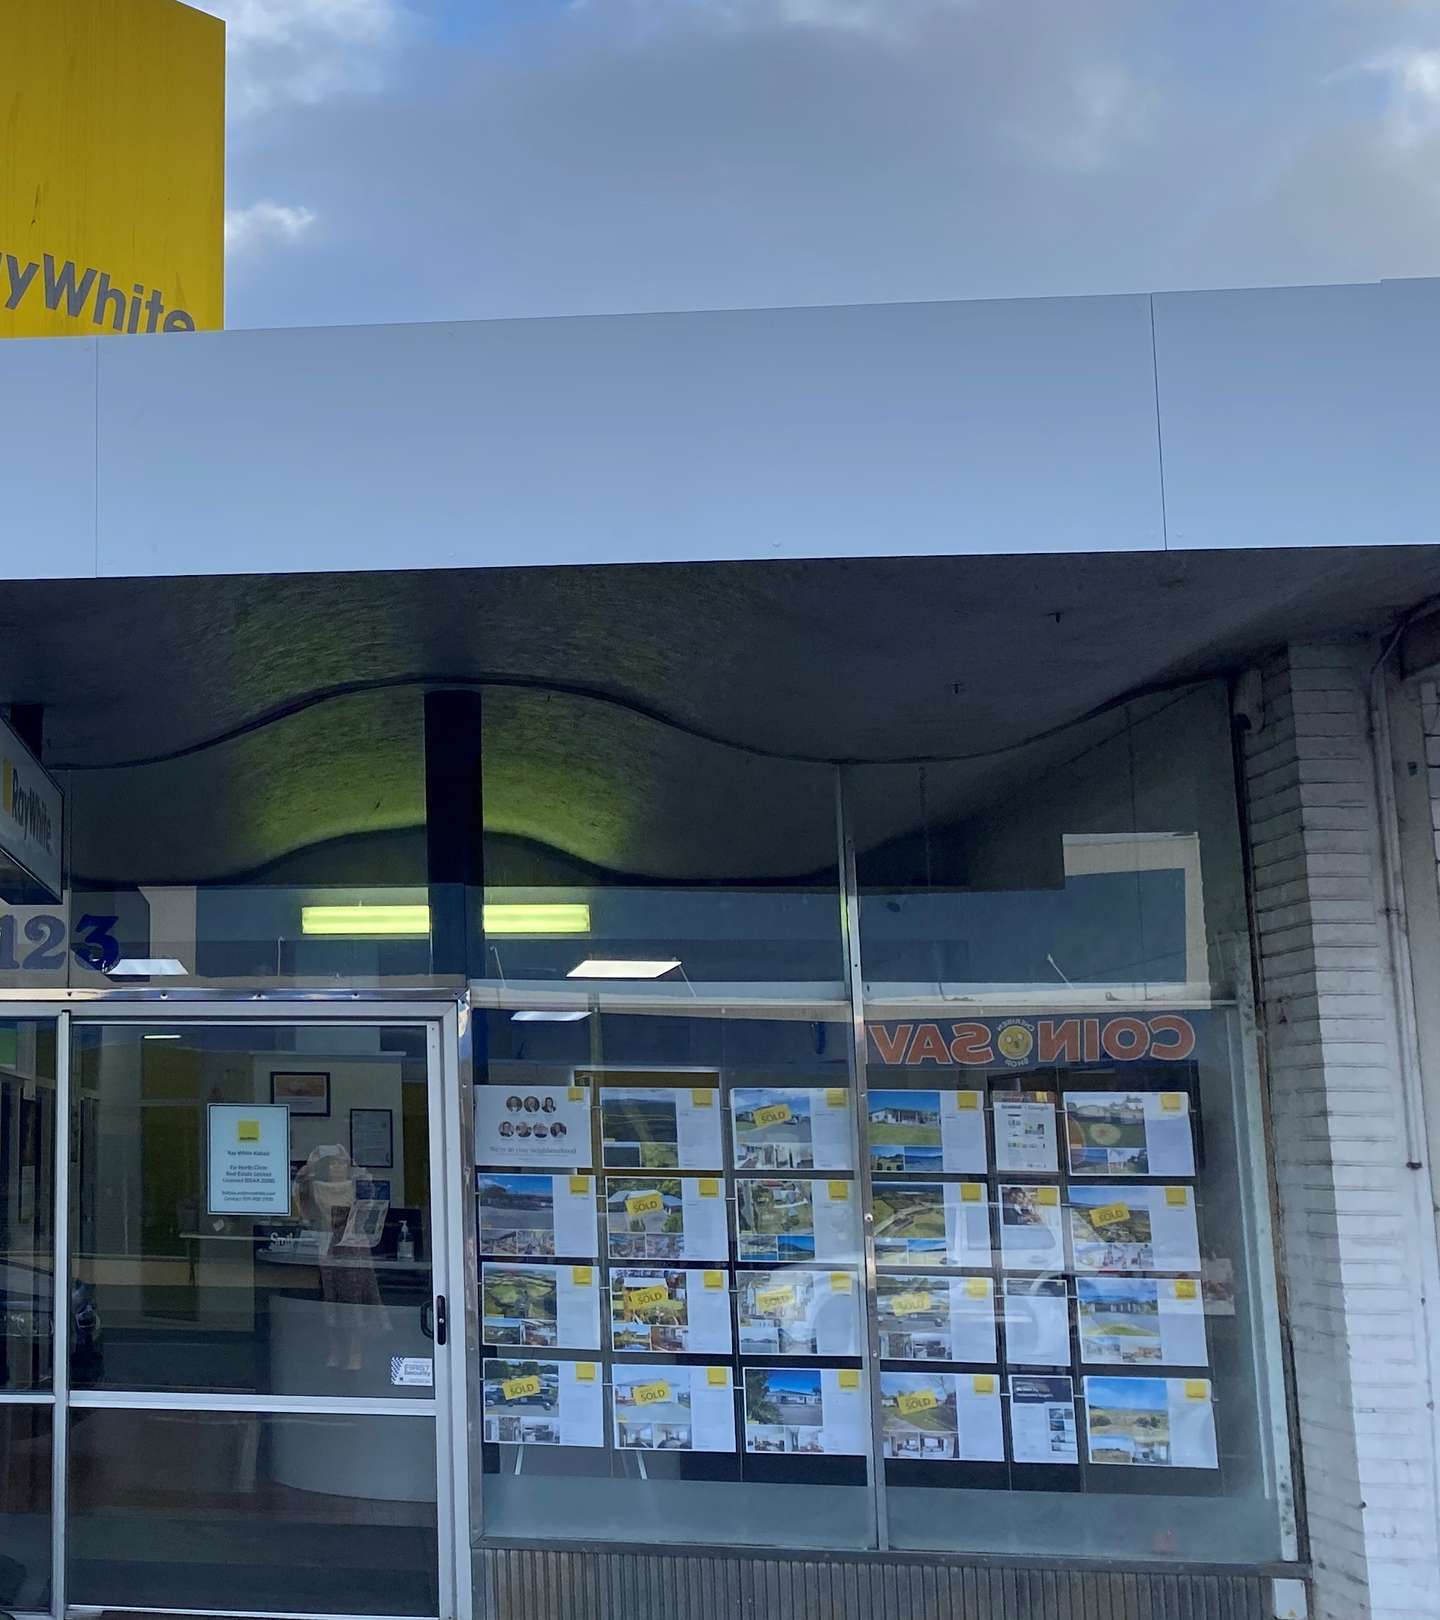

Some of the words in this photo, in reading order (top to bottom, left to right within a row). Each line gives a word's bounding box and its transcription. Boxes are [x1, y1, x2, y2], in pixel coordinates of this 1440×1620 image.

[761, 1111, 786, 1123] SOLD
[633, 1202, 658, 1213] SOLD
[1099, 1210, 1124, 1221] SOLD
[637, 1293, 663, 1304] SOLD
[510, 1384, 535, 1395] SOLD
[640, 1389, 665, 1400] SOLD
[906, 1397, 930, 1409] SOLD
